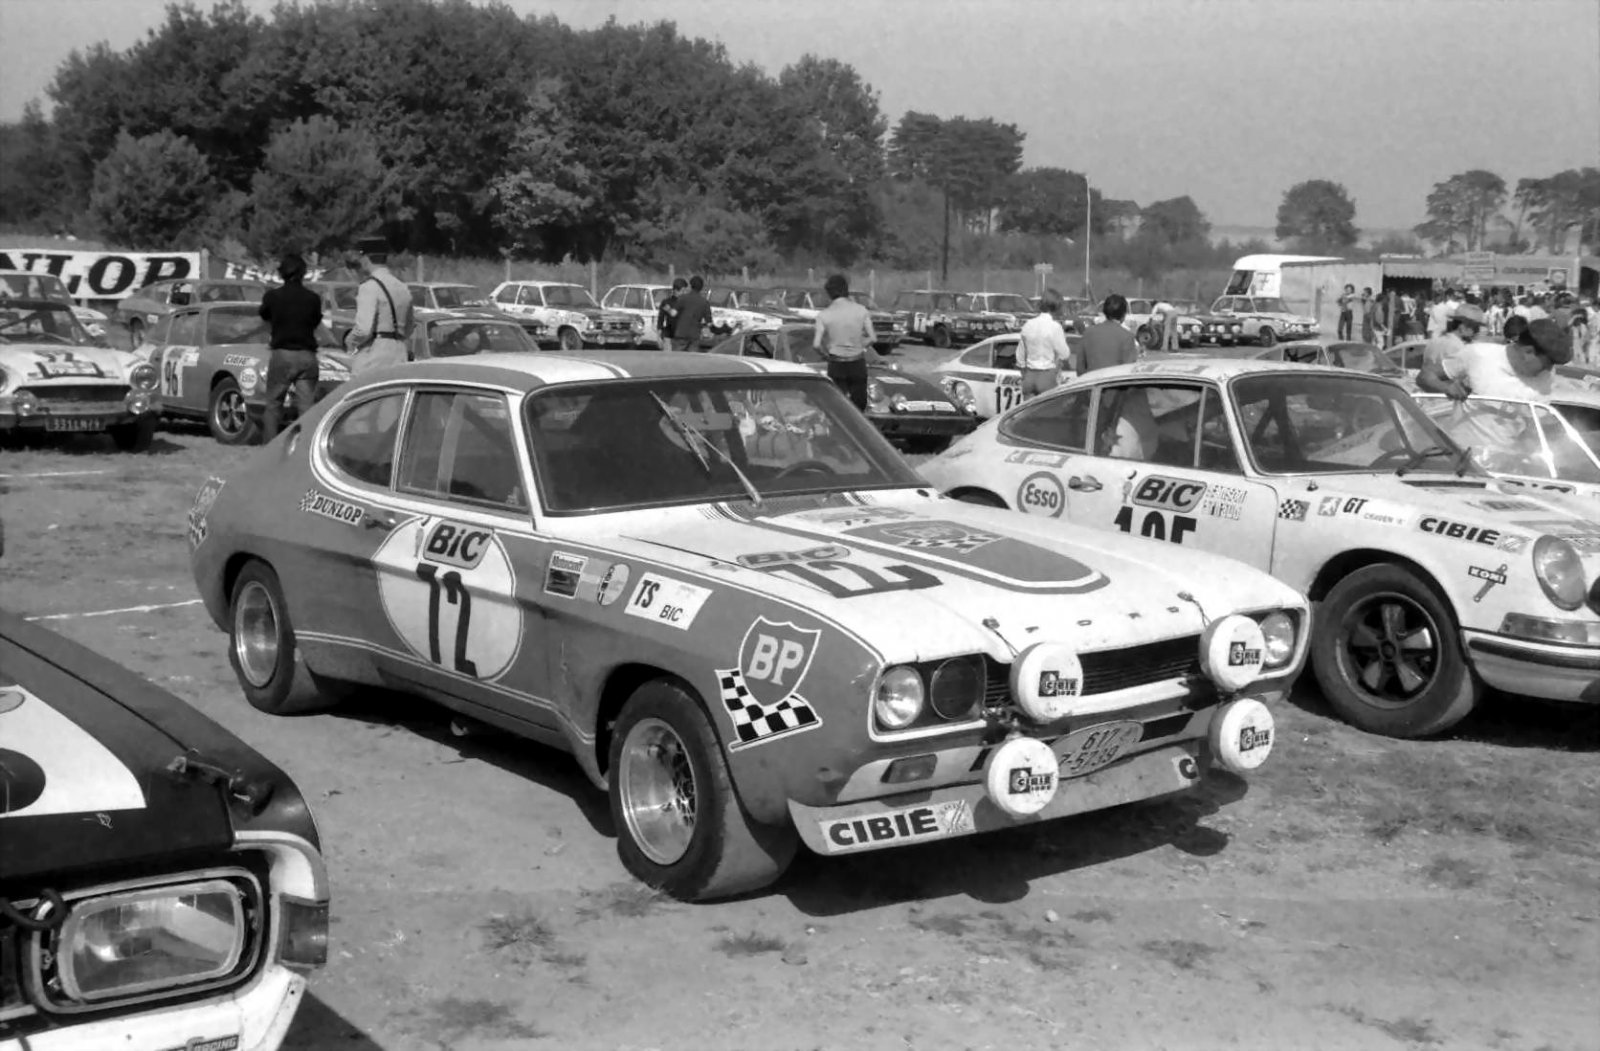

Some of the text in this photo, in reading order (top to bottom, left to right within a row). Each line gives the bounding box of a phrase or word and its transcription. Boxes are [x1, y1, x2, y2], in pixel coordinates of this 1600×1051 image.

[312, 497, 362, 522] DUNLOP
[1343, 497, 1368, 514] GT
[1470, 567, 1505, 583] KONI
[634, 579, 660, 609] TS
[416, 562, 479, 678] 12
[659, 605, 683, 622] BIC
[745, 633, 805, 686] BP
